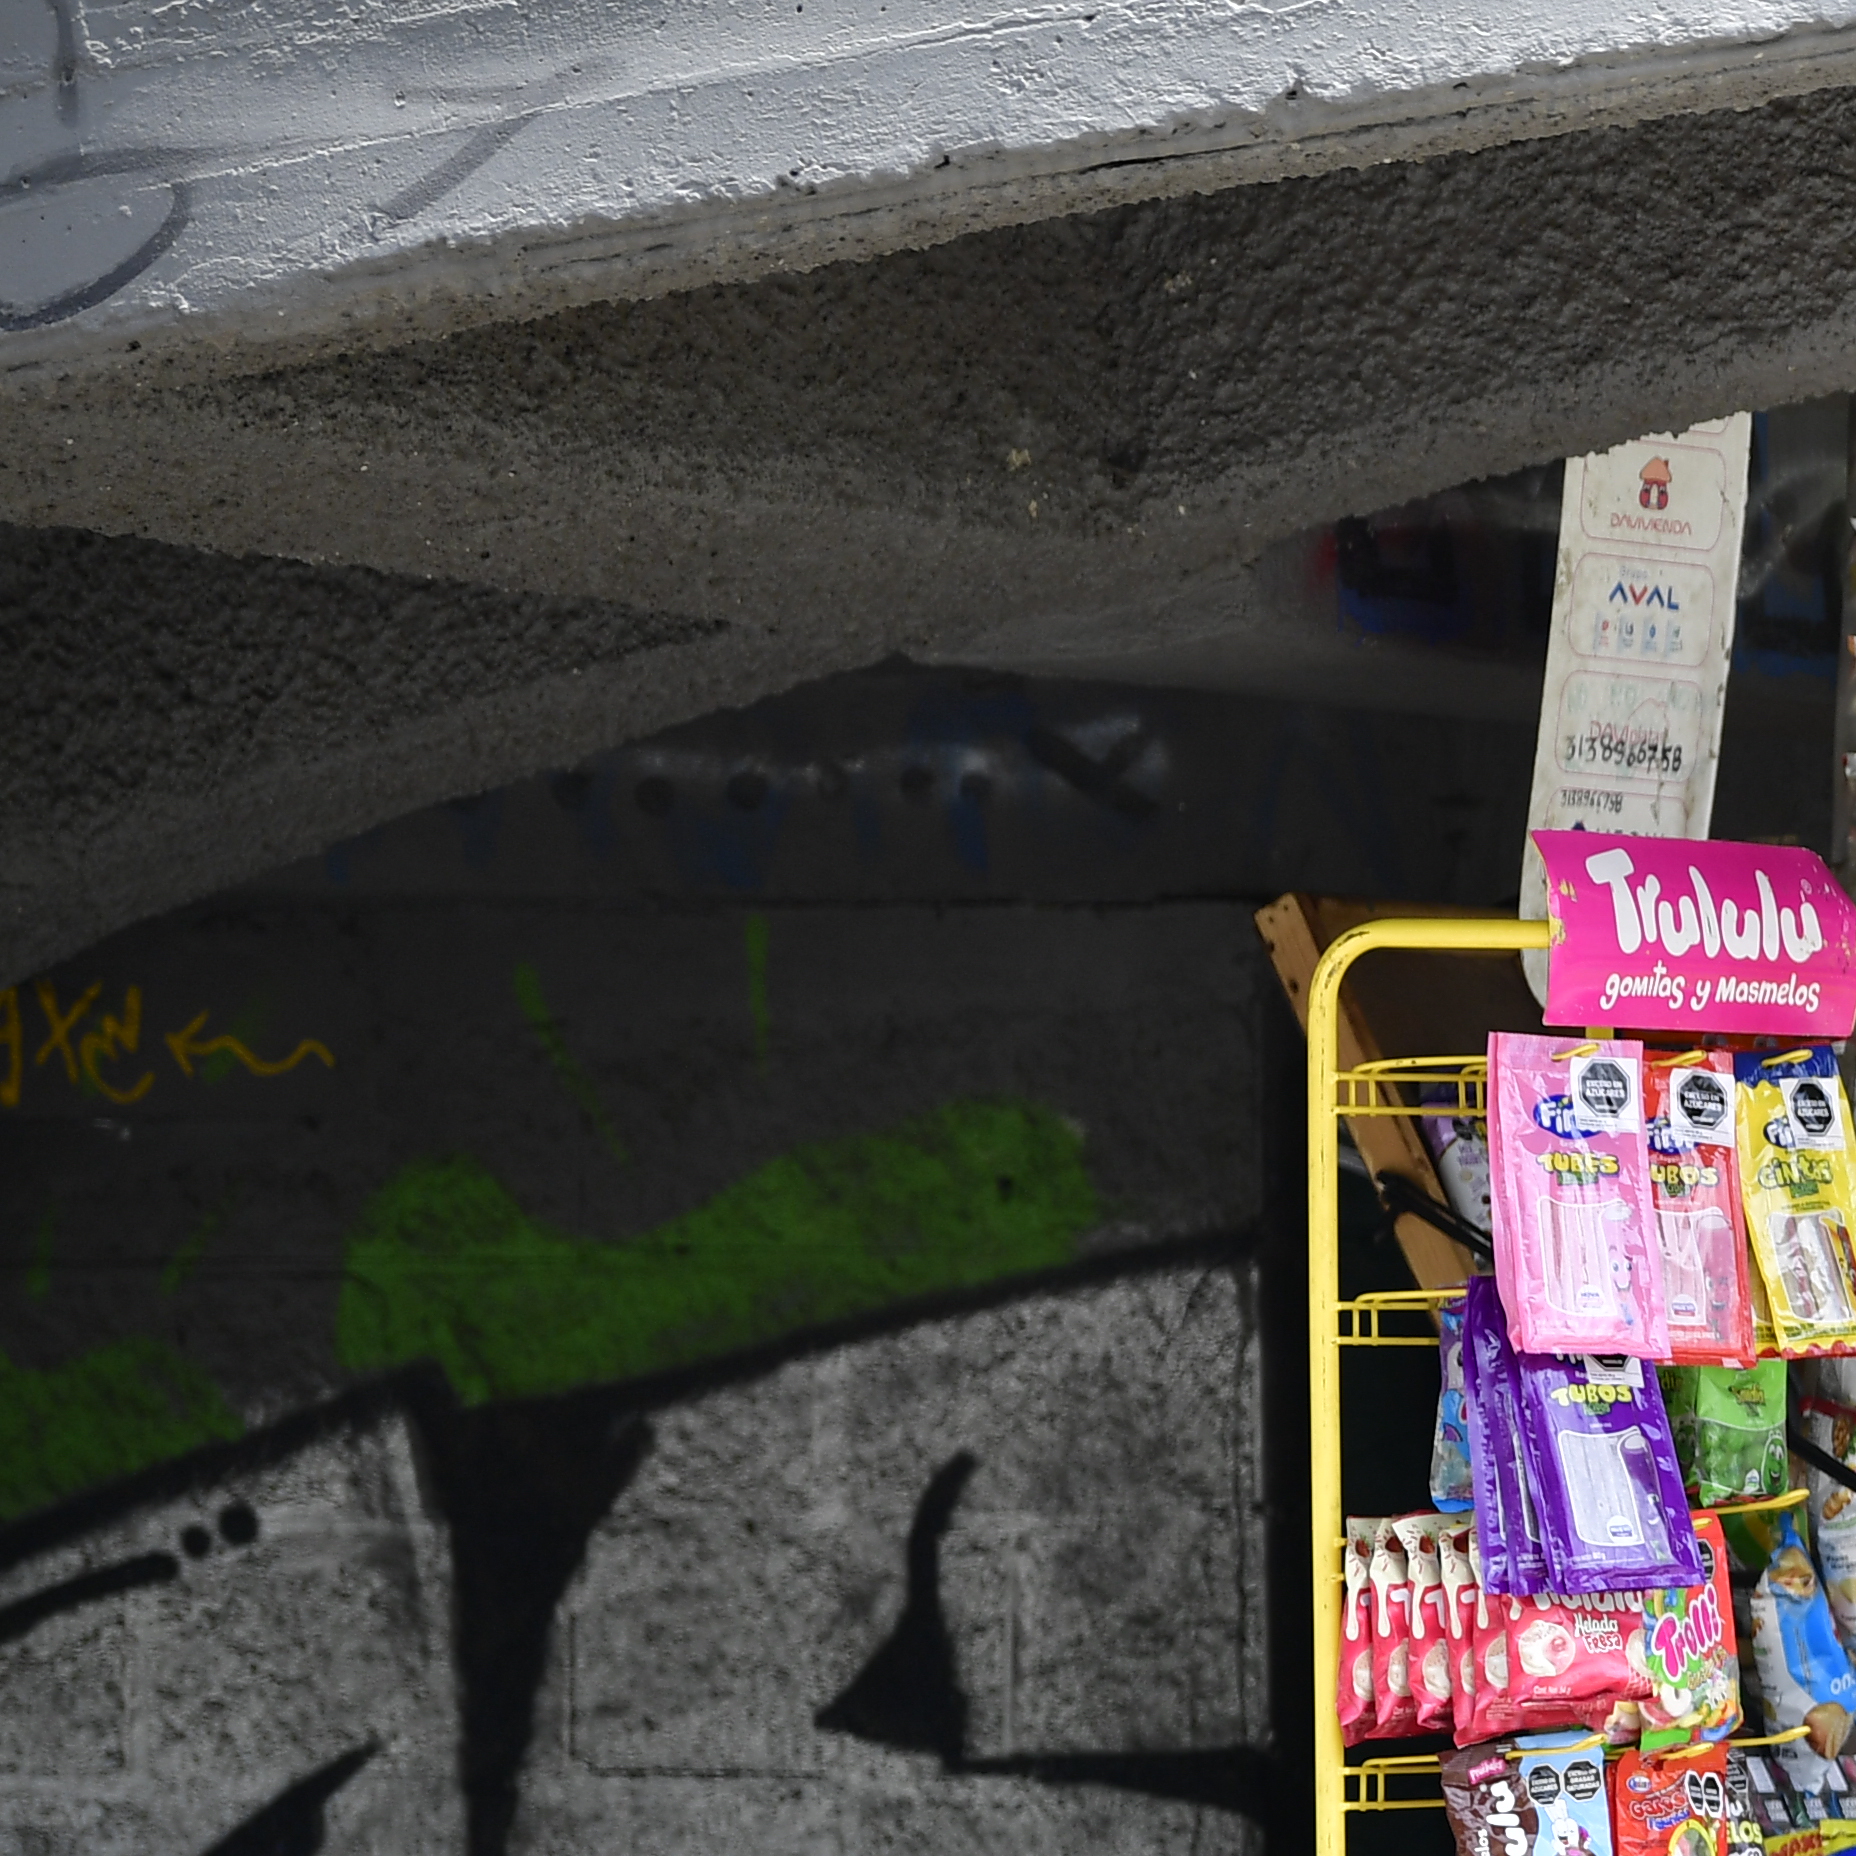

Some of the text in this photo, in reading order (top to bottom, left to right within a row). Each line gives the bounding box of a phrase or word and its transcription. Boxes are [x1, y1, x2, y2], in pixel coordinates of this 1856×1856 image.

[1610, 513, 1691, 536] DAVIVIENDA
[1609, 585, 1679, 610] AVAL
[1586, 848, 1822, 963] Trululu
[1600, 960, 1821, 1013] gomitas y Masmelos
[1651, 1164, 1719, 1186] UBOS
[1550, 1383, 1633, 1406] TUBOS
[1652, 1584, 1721, 1682] Trolli
